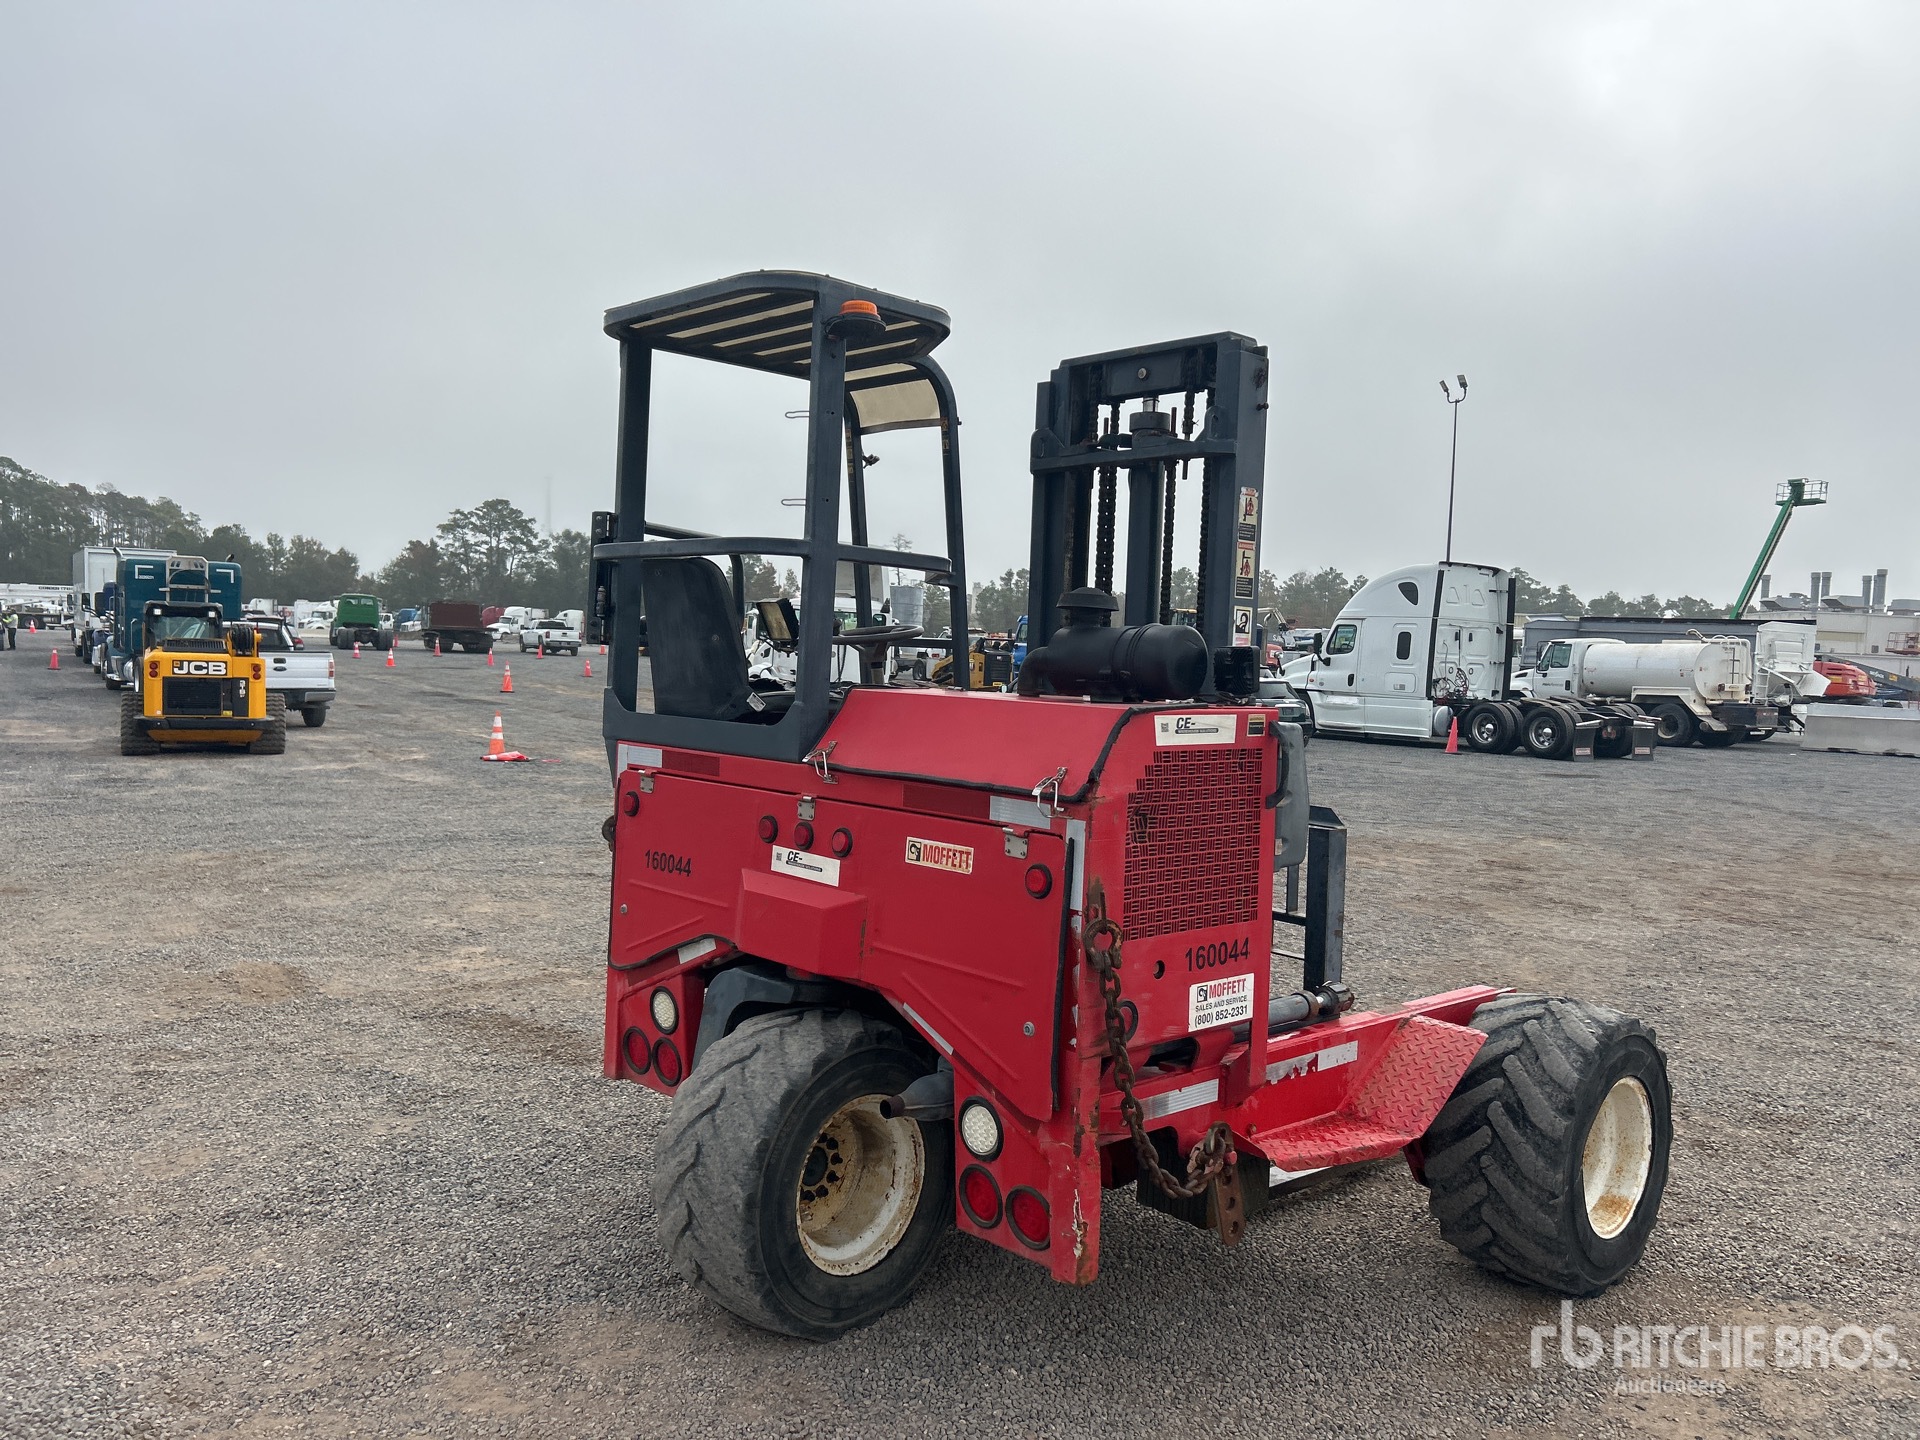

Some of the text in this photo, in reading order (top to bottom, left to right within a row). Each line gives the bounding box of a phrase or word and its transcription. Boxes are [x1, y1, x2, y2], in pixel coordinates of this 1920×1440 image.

[173, 661, 227, 675] JCB
[645, 849, 692, 877] 160044
[922, 843, 972, 870] MOFFETT
[1185, 937, 1249, 971] 160044
[1208, 978, 1247, 999] MOFFETT
[1195, 995, 1248, 1012] SALES AND SERVICE
[1194, 1004, 1248, 1028] (800) 852-2331
